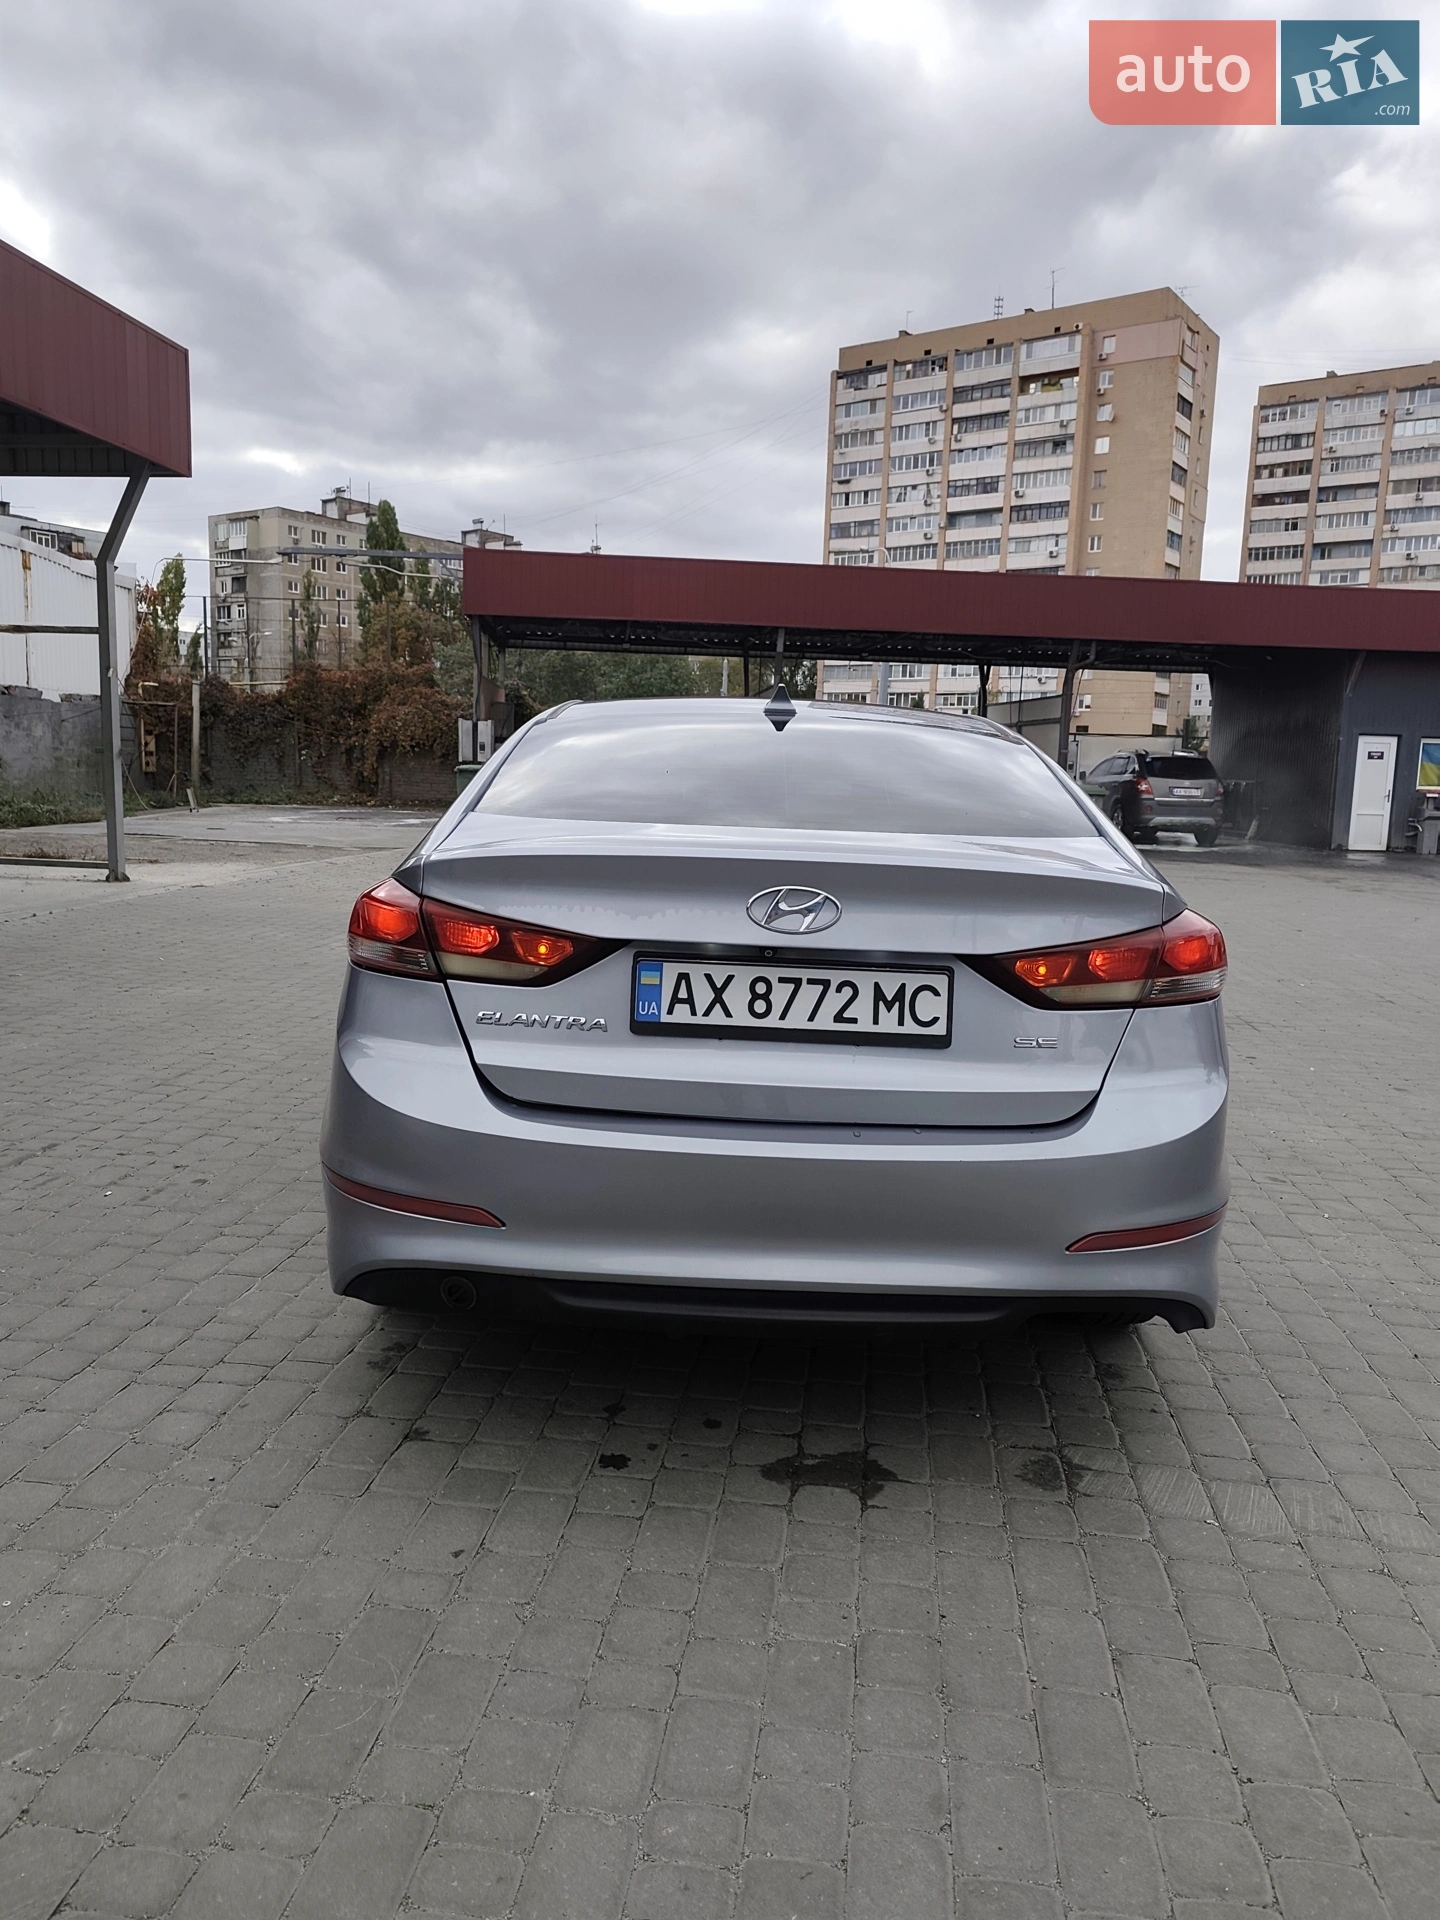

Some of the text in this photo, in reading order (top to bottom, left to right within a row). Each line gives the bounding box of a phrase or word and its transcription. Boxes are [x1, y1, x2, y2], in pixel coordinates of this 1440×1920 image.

[638, 1000, 659, 1016] UA
[665, 971, 942, 1028] AX 8772 MC
[475, 1010, 608, 1032] ELANTRA
[1013, 1037, 1058, 1049] SE
